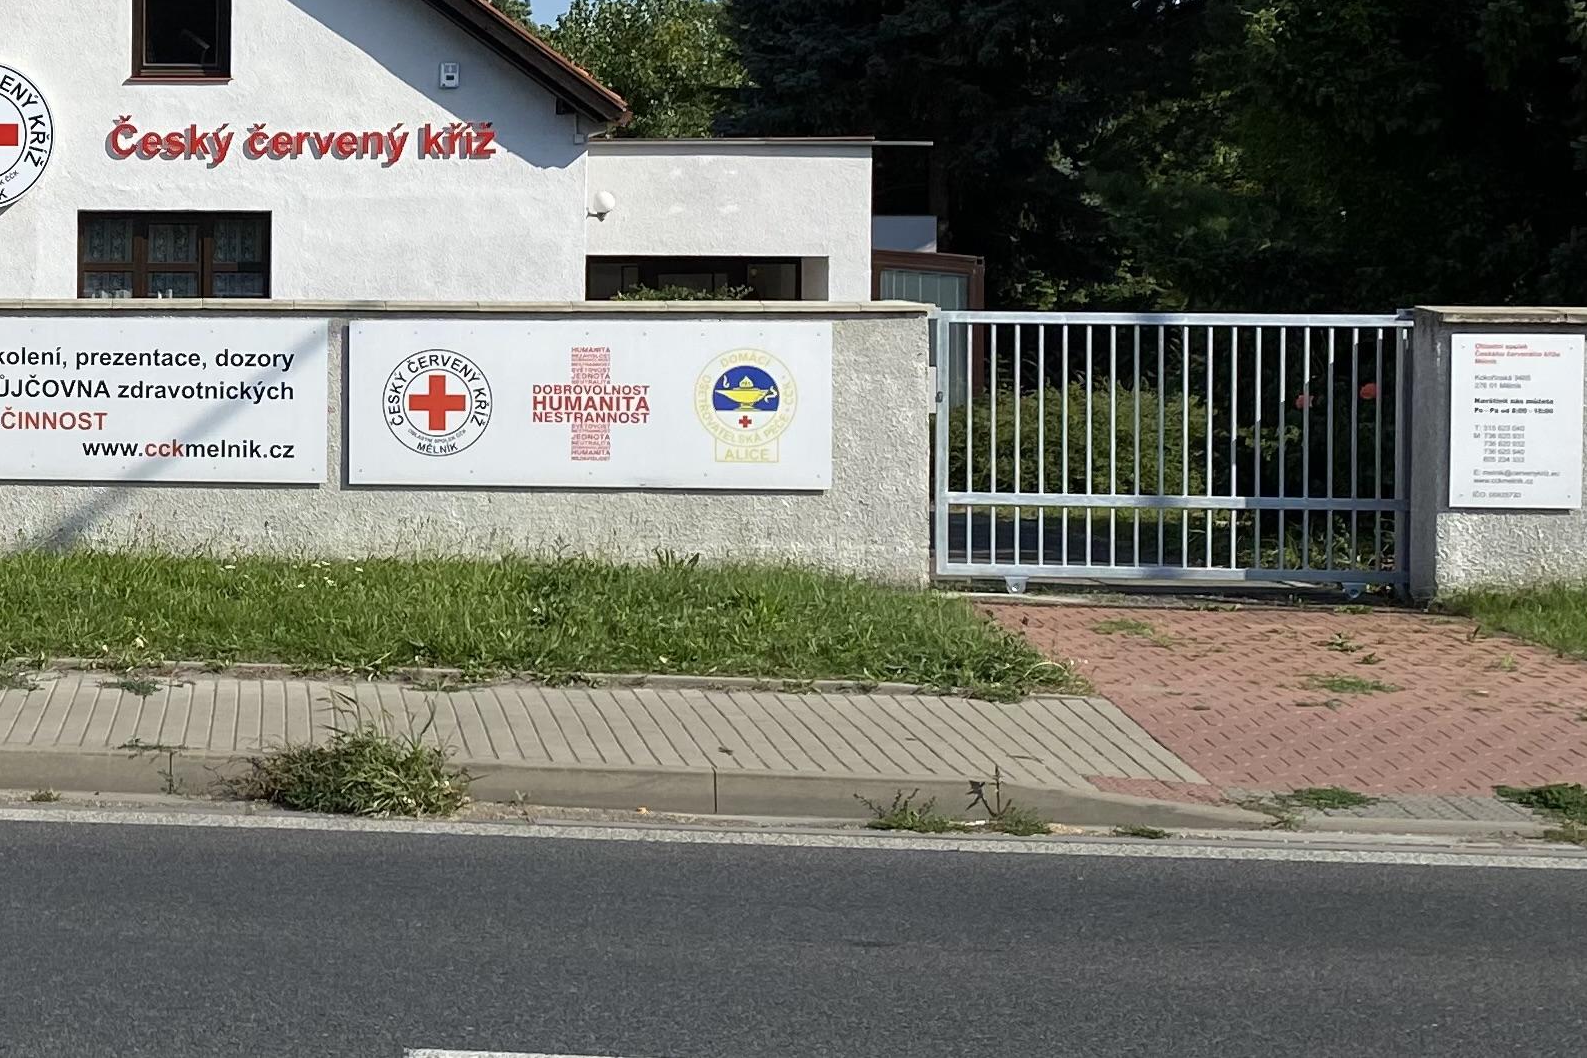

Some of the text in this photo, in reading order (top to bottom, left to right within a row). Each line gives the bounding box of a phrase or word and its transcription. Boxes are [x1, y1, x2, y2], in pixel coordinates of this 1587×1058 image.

[23, 114, 51, 168] KŘÍŽ
[111, 115, 498, 166] Český červený kříž
[4, 169, 20, 182] ČČK
[75, 350, 207, 372] prezentace,
[215, 350, 295, 372] dozory
[117, 379, 295, 404] zdravotnických
[387, 354, 490, 427] ČESKÝ ČERVENÝ KŘÍŽ
[532, 384, 650, 395] DOBROVOLNOST
[532, 395, 650, 411] HUMANITA
[0, 407, 108, 431] ČINNOST
[532, 411, 650, 423] NESTRANNOST
[82, 438, 295, 459] www.cckmelnik.cz
[416, 442, 459, 454] MĚLNÍK
[724, 448, 770, 460] ALICE
